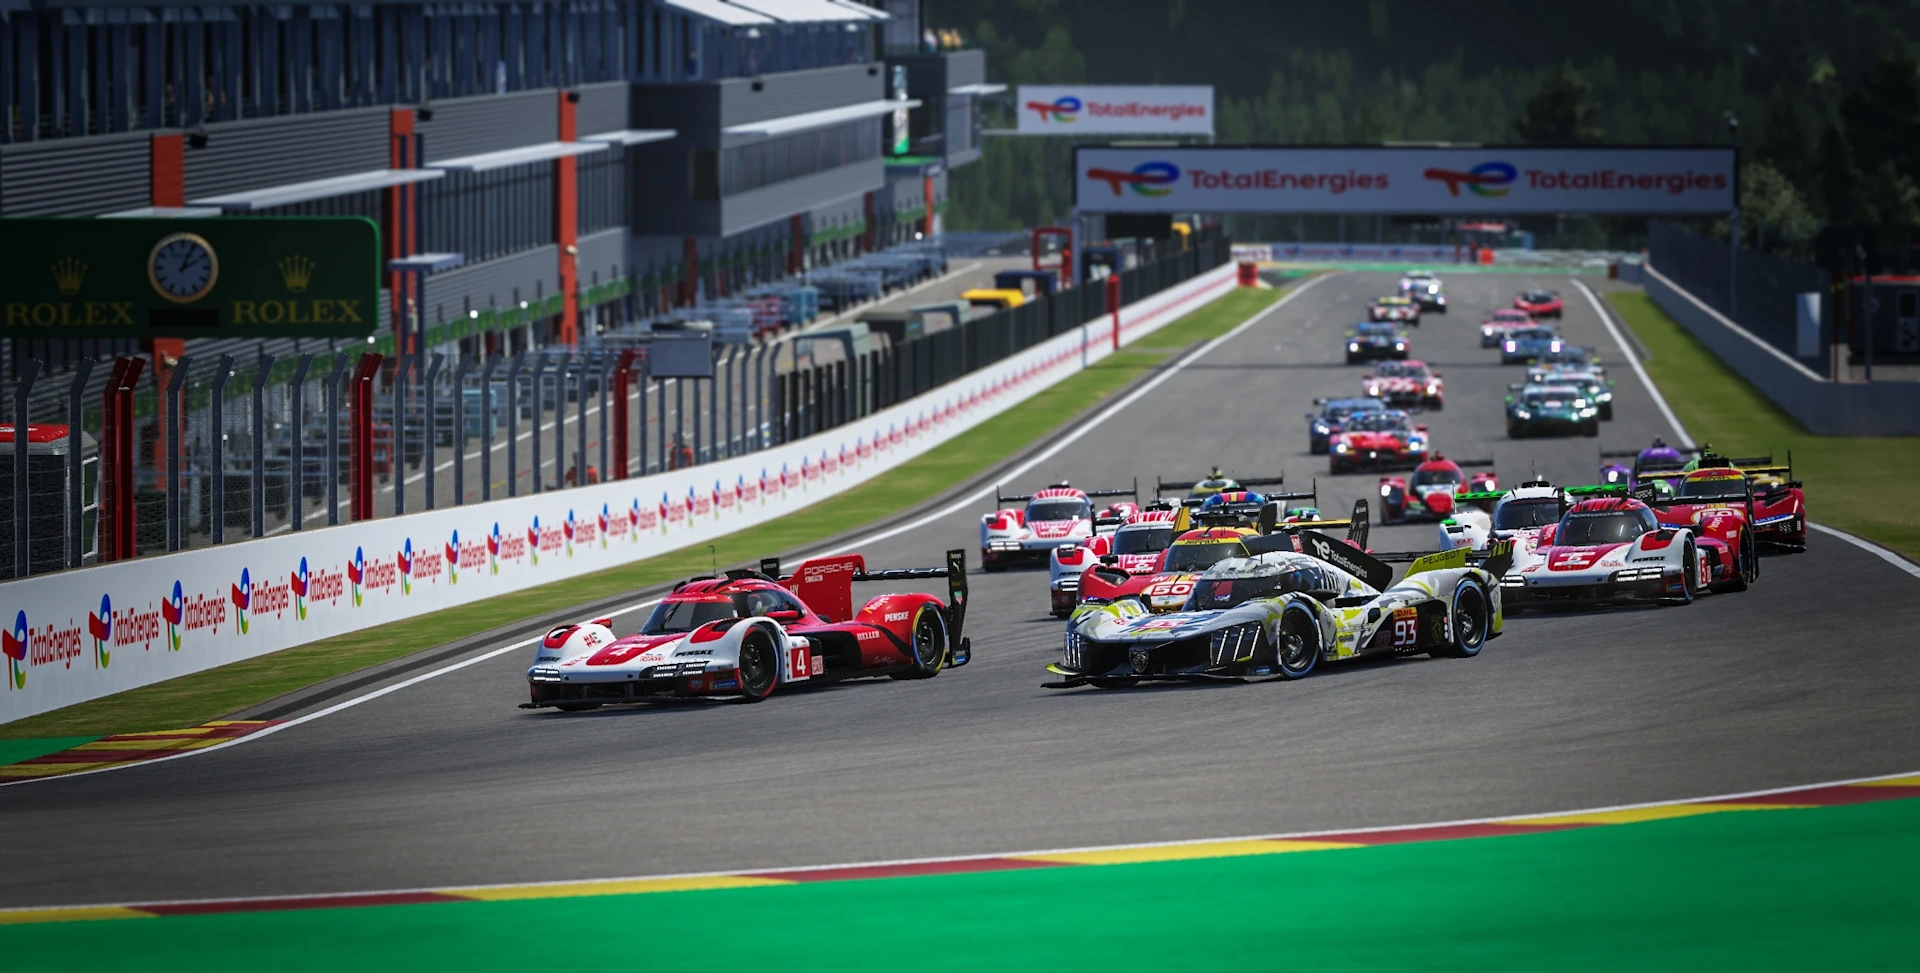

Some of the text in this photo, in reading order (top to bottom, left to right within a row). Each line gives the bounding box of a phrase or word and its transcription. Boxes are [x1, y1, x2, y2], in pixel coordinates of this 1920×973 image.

[1085, 102, 1206, 121] TotalEnergies
[1187, 168, 1389, 195] TotalEnergies
[1525, 168, 1728, 195] TotalEnergies
[4, 302, 135, 326] ROLEX
[231, 300, 363, 324] ROLEX
[804, 562, 853, 576] PORSCHE
[1330, 549, 1368, 579] TotalEnergies
[1422, 550, 1461, 565] PEUGEOT
[308, 564, 343, 606] TotalEnergies
[364, 550, 396, 594] TotalEnergies
[805, 575, 824, 583] 963
[251, 576, 289, 619] TotalEnergies
[1153, 585, 1191, 595] 50
[183, 589, 226, 635] TotalEnergies
[884, 611, 910, 623] PENSKE
[112, 603, 159, 651] TotalEnergies
[1393, 620, 1417, 646] 93
[29, 618, 81, 670] TotalEnergies
[675, 649, 714, 657] PENSKE
[796, 649, 806, 675] 4
